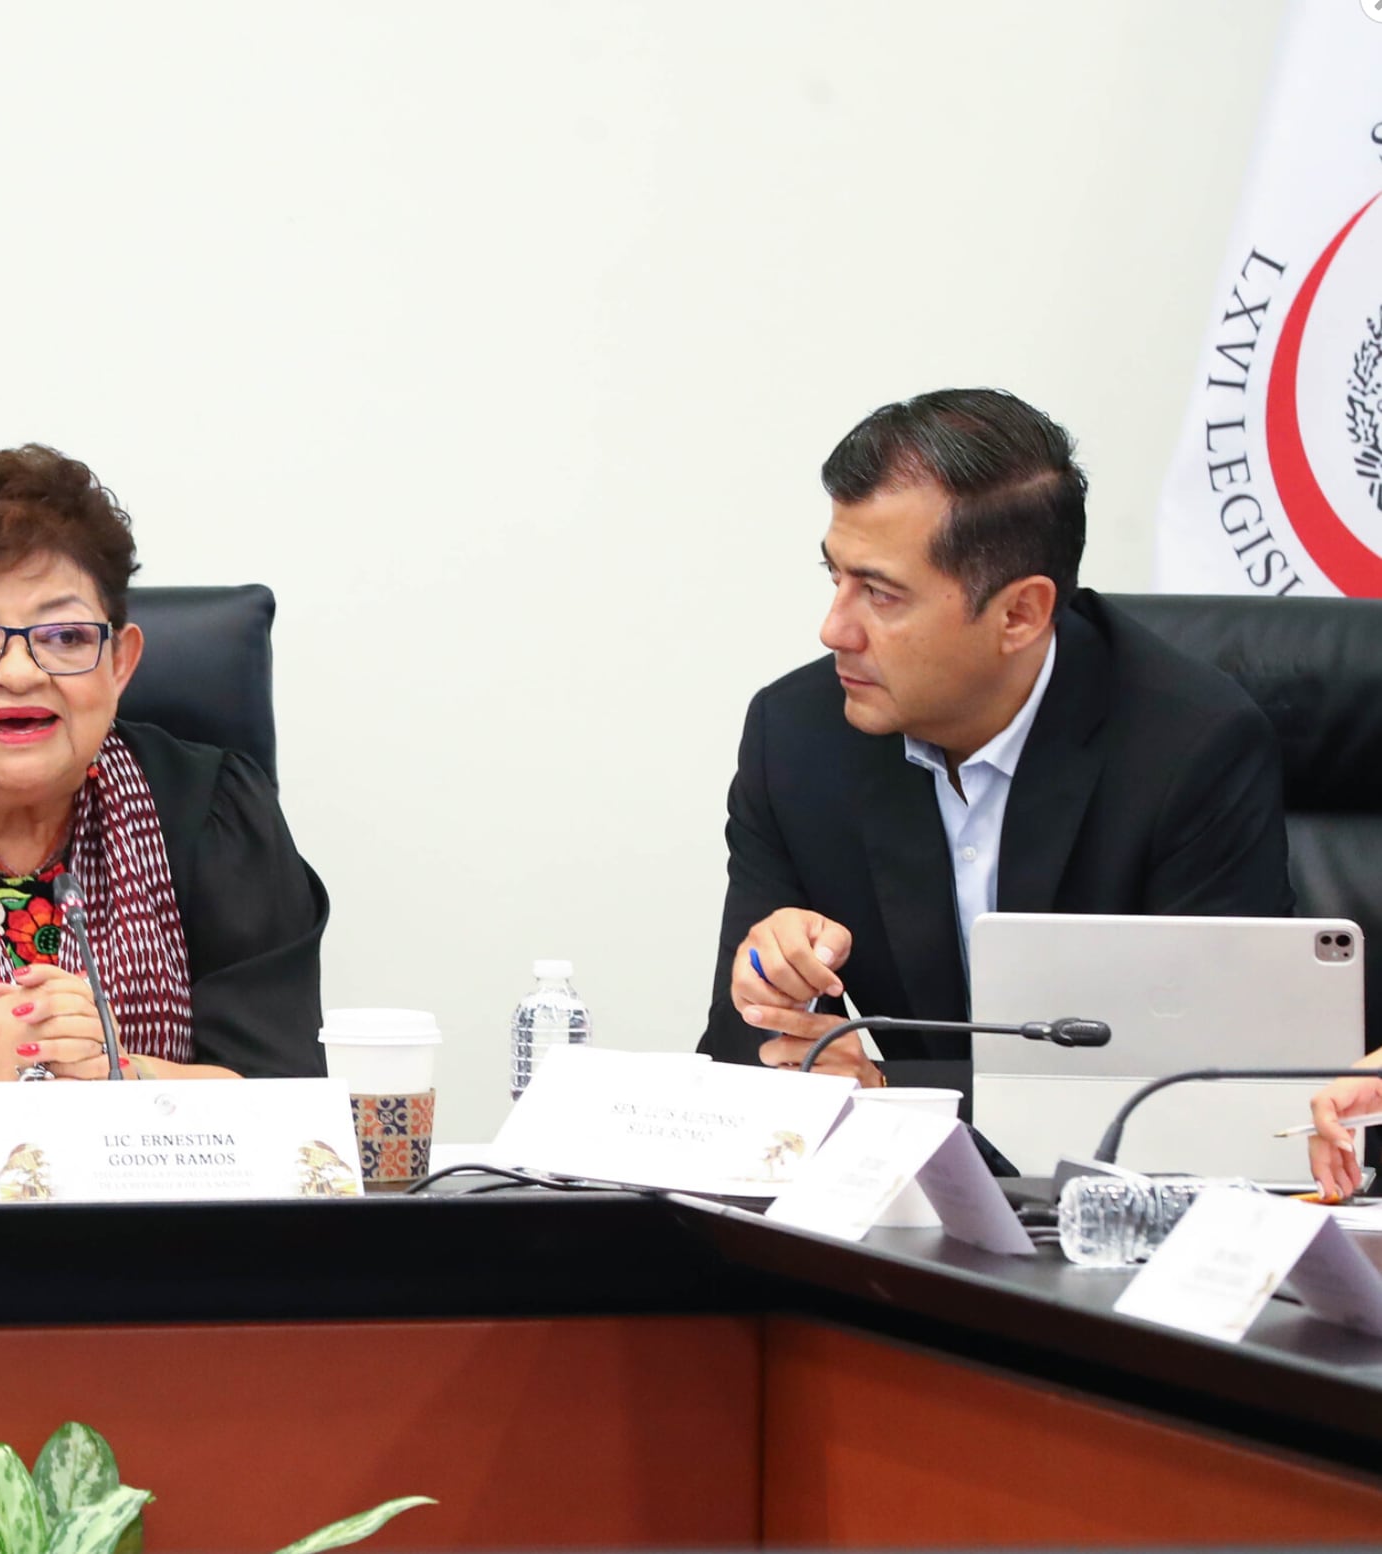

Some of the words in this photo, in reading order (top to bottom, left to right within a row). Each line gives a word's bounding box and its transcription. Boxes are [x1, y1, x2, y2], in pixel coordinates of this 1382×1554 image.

[1207, 246, 1288, 394] LXVI
[141, 1133, 235, 1147] ERNESTINA
[108, 1153, 169, 1167] GODOY
[175, 1152, 236, 1166] RAMOS
